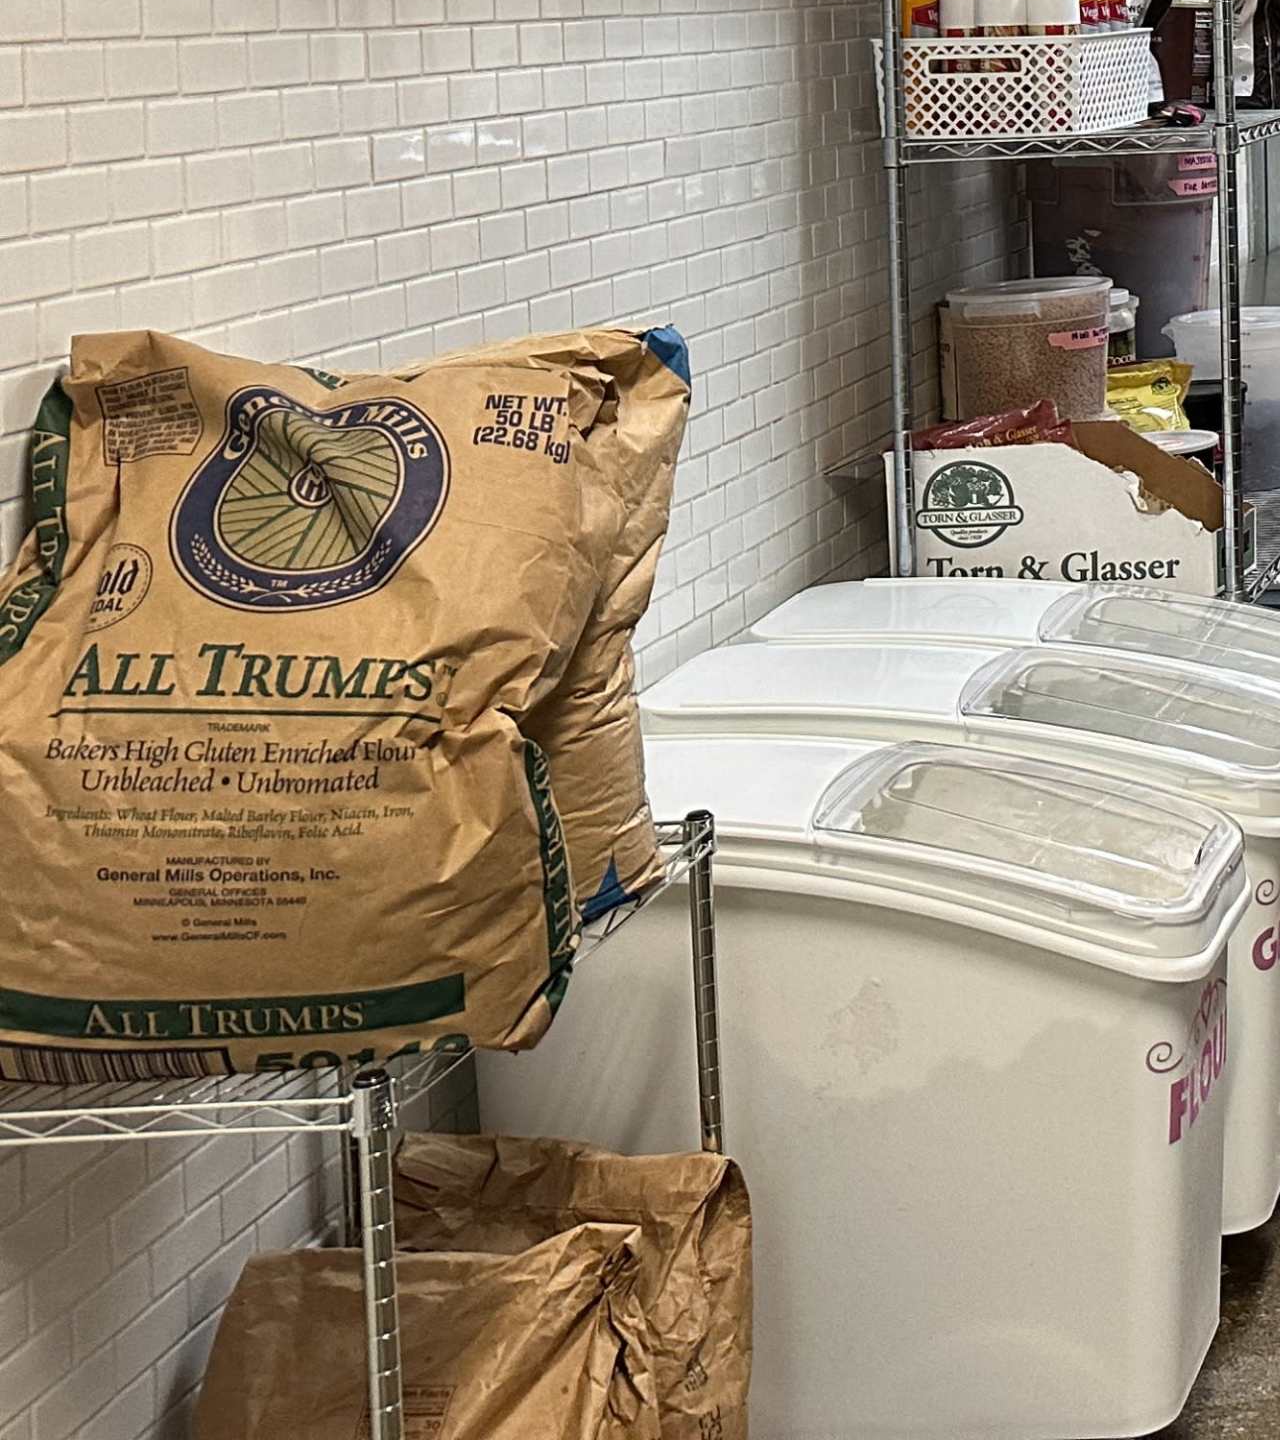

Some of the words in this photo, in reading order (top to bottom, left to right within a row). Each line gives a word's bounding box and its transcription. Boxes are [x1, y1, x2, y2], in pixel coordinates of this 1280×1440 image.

[485, 393, 526, 410] NET
[533, 395, 568, 417] WT.
[495, 409, 523, 427] 50
[528, 412, 555, 432] LB
[357, 403, 430, 461] Mills
[472, 425, 537, 451] (22.68
[543, 434, 571, 464] kg)
[921, 513, 954, 525] TORN
[955, 511, 969, 524] &
[969, 510, 1017, 523] GLASSER
[96, 558, 140, 596] old
[926, 557, 1004, 579] Torn
[1017, 555, 1050, 581] &
[1060, 550, 1181, 583] Glasser
[62, 642, 177, 697] ALL
[195, 642, 437, 701] TRUMPS
[44, 738, 121, 761] Bakers
[125, 736, 175, 769] High
[184, 739, 256, 765] Gluten
[263, 738, 357, 765] Enriched
[363, 738, 418, 761] Flour
[80, 766, 214, 793] Unbleached
[236, 766, 380, 794] Unbromated
[96, 867, 160, 883] General
[165, 868, 205, 883] Mills
[209, 867, 306, 885] Operations,
[309, 867, 341, 881] Inc.
[84, 1003, 170, 1039] ALL
[178, 1000, 366, 1037] TRUMPS
